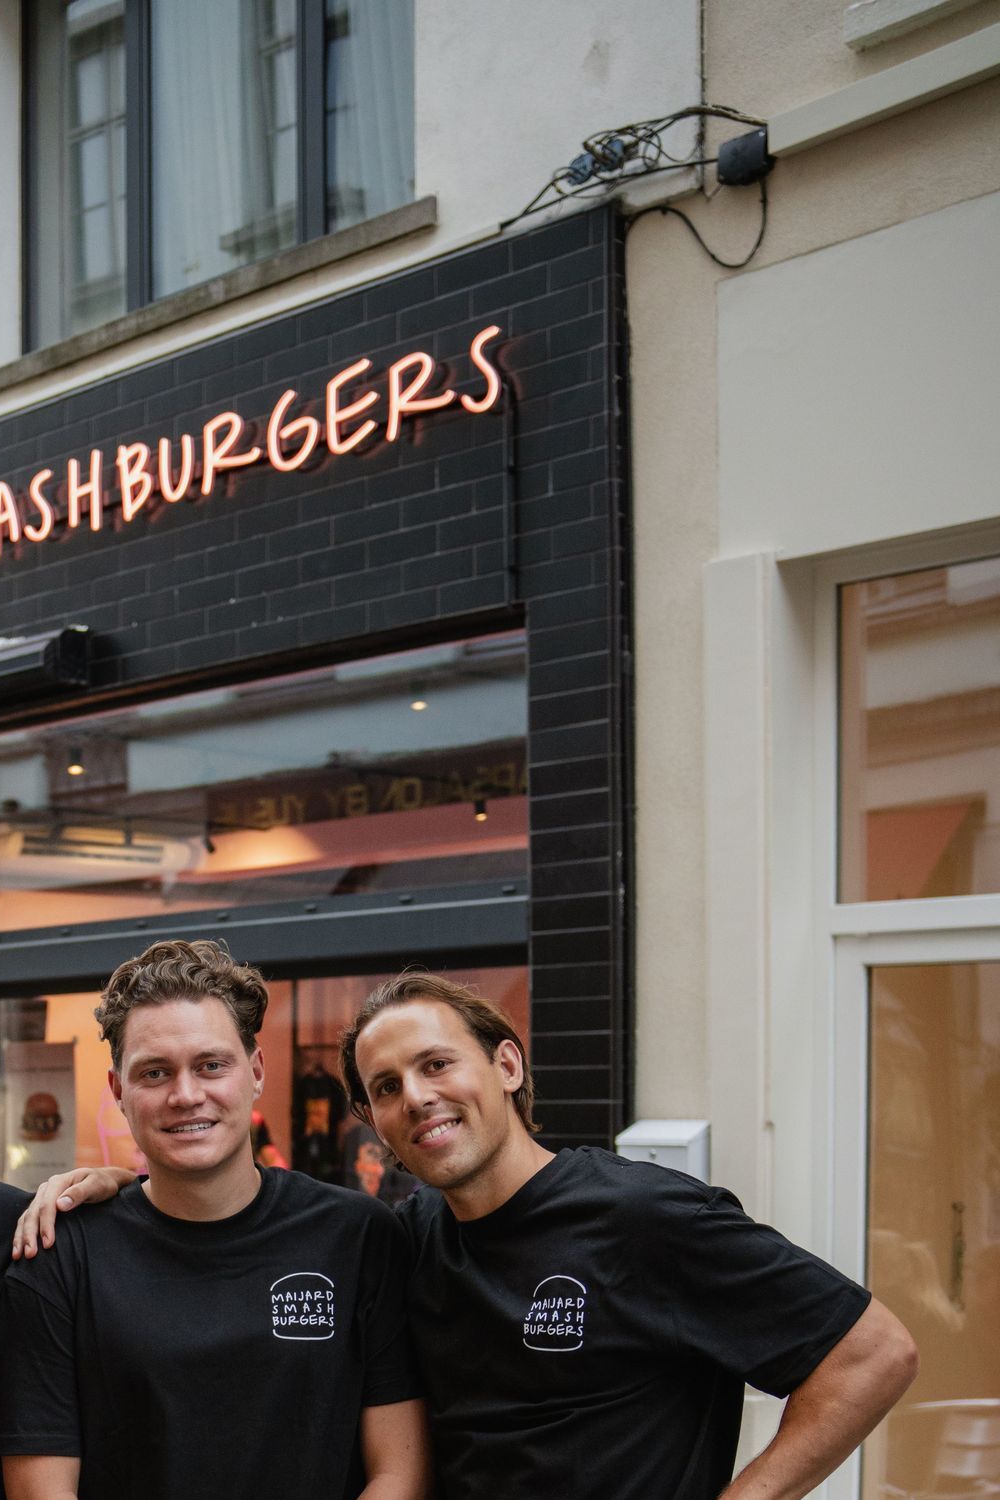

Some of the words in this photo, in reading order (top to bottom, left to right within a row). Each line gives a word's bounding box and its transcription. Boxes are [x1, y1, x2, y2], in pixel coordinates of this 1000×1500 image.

[271, 1290, 334, 1304] MAIJARD
[530, 1297, 585, 1311] MAIJARD
[272, 1302, 334, 1315] SMASH
[272, 1314, 334, 1327] BURGERS
[525, 1310, 584, 1324] SMASH
[523, 1323, 584, 1337] BURGERS
